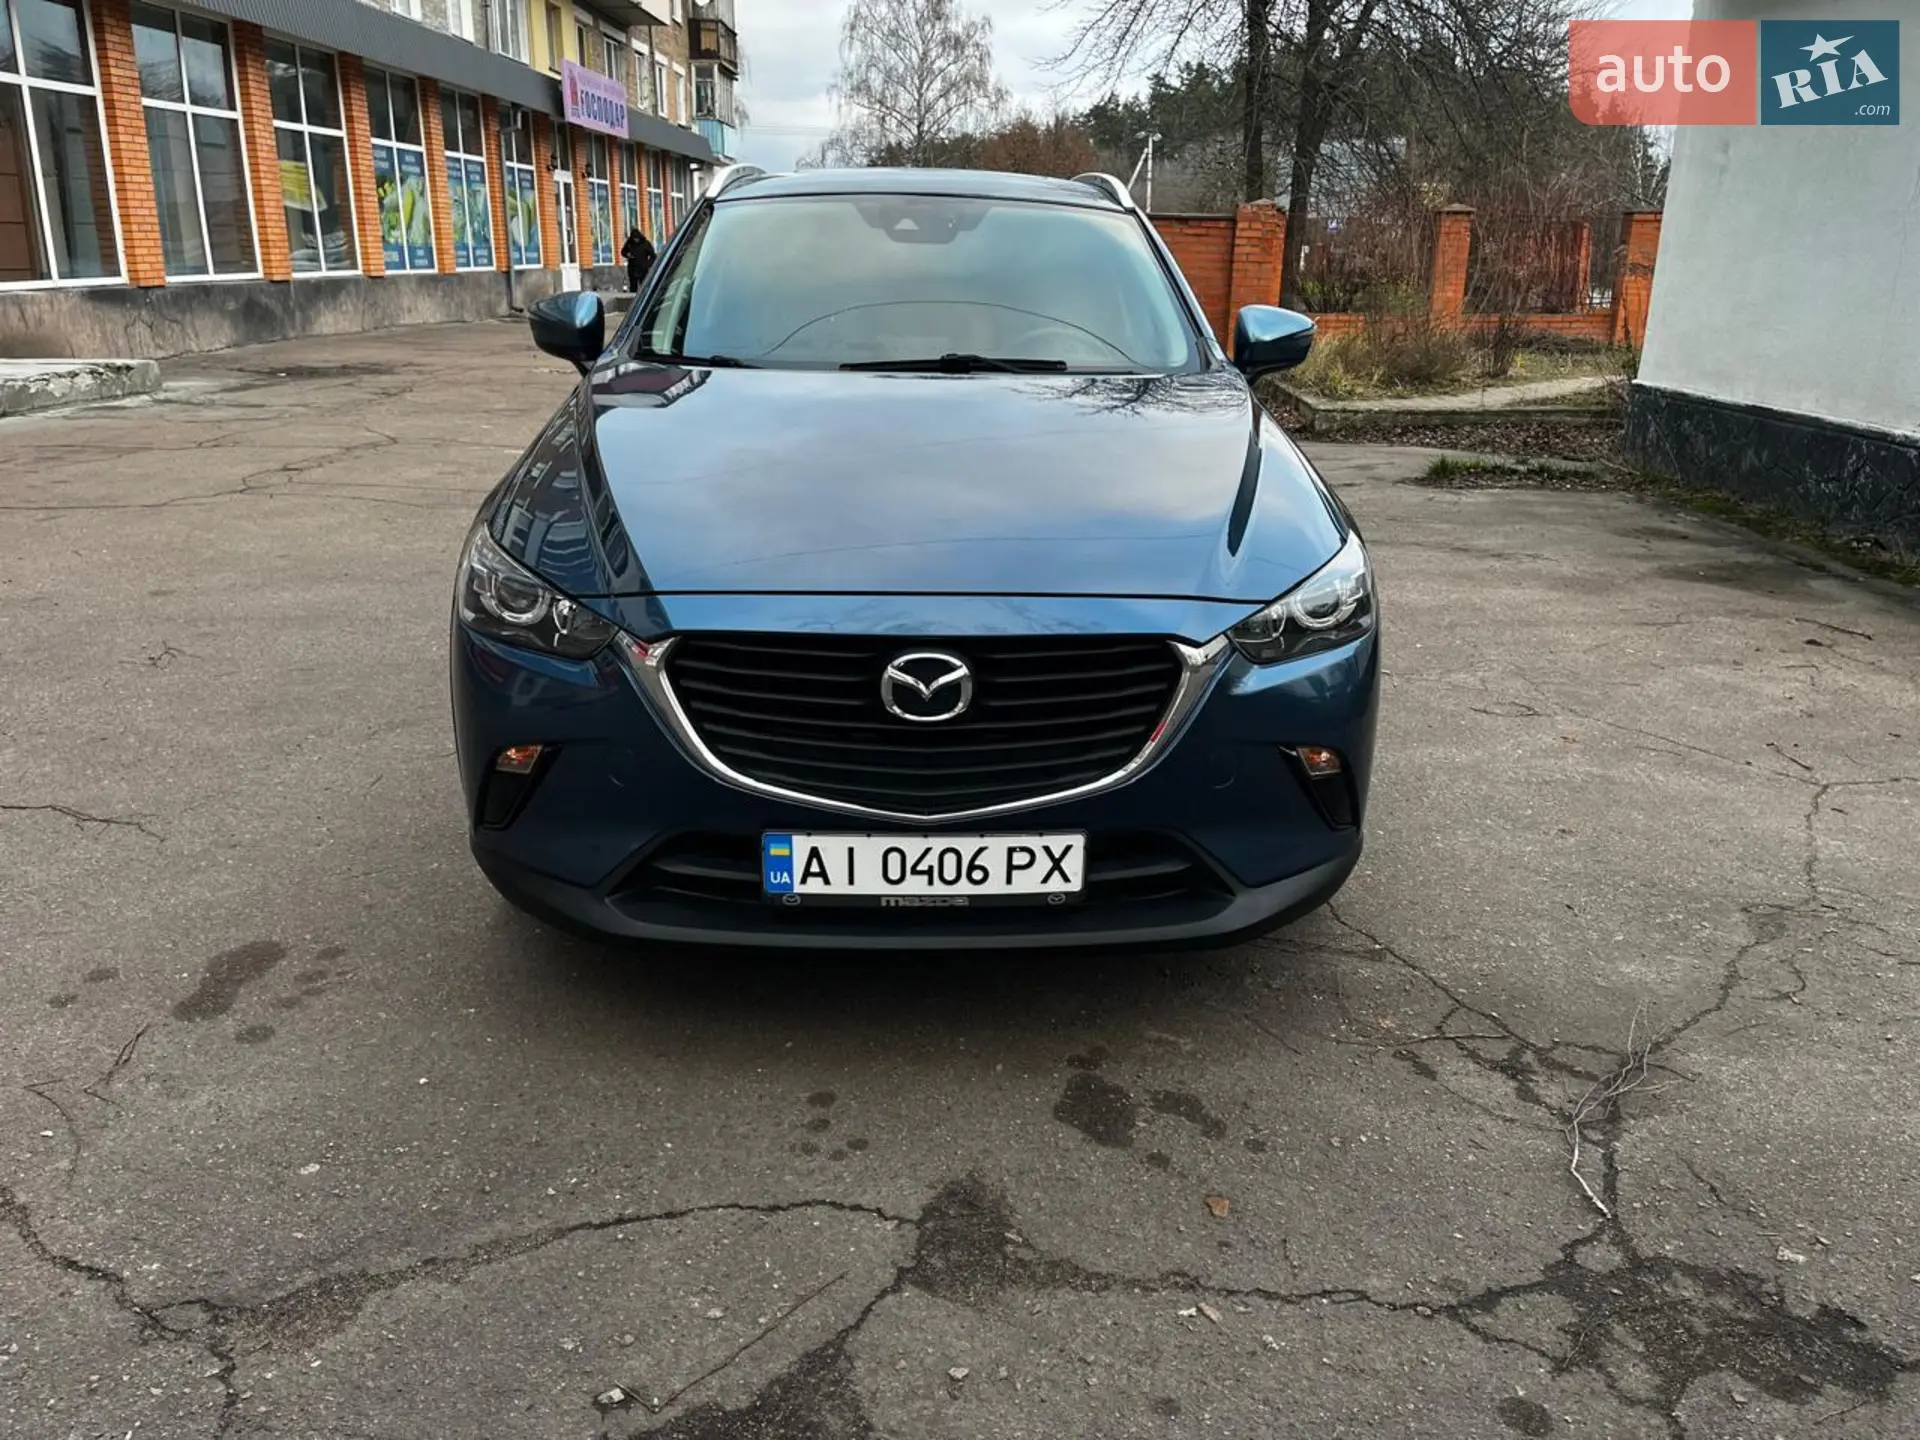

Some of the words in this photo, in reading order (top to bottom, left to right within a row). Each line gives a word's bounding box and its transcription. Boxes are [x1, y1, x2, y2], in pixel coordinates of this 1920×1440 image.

[770, 872, 791, 884] UA
[800, 846, 855, 886] AI
[881, 846, 990, 886] 0406
[1005, 844, 1074, 885] PX
